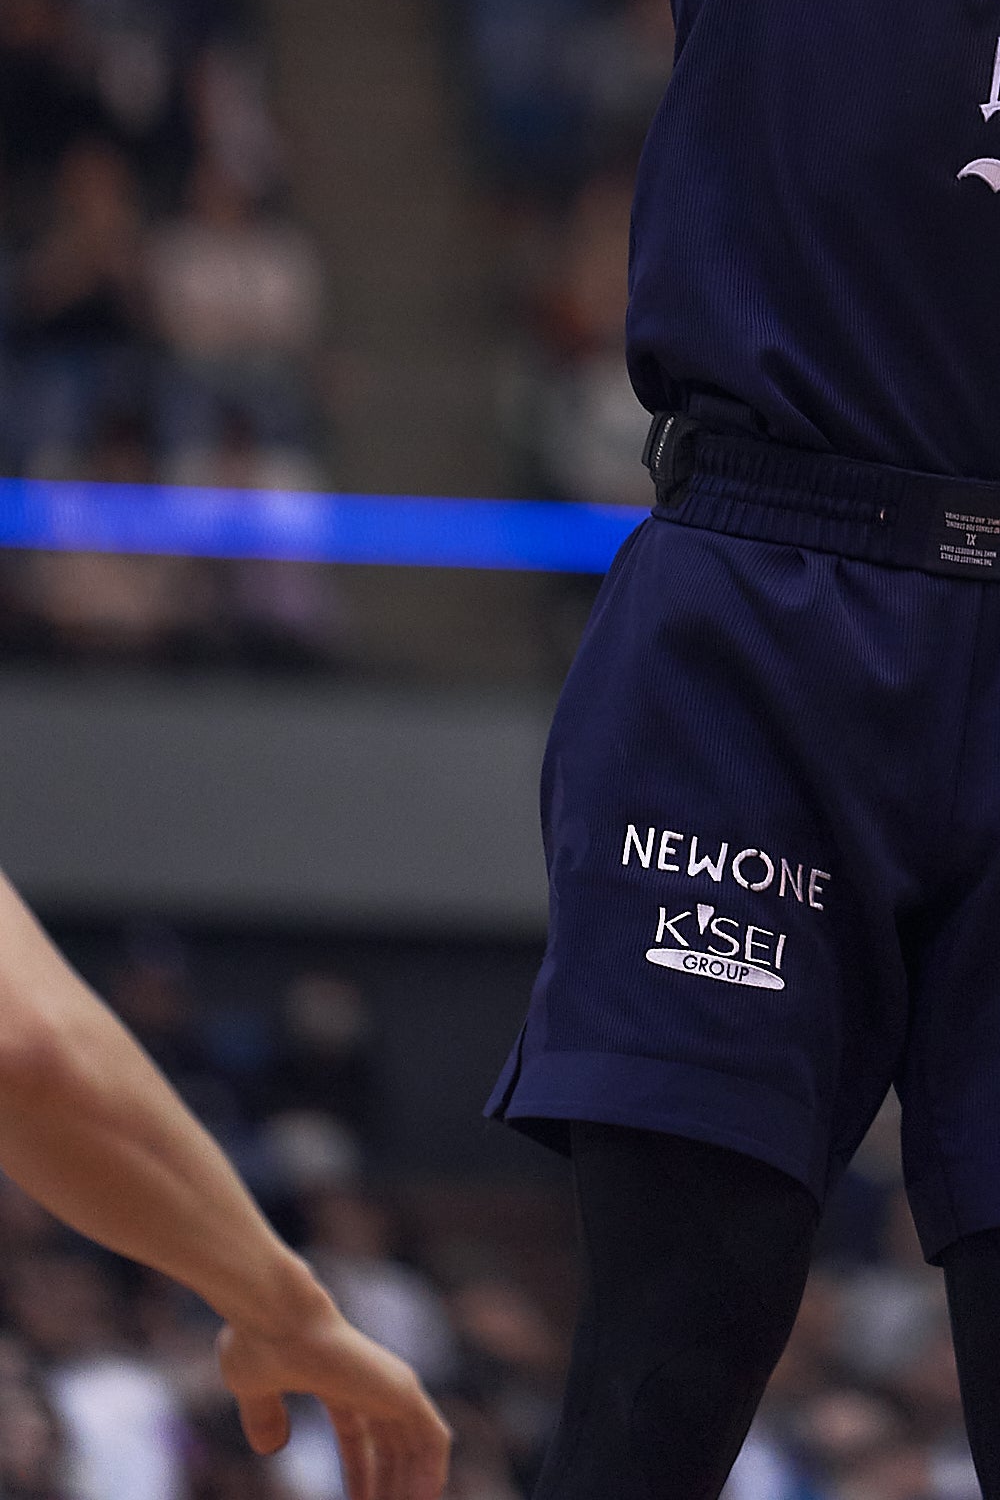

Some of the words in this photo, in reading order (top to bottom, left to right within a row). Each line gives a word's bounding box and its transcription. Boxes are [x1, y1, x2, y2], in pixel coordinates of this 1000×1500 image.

[966, 533, 976, 546] XL
[621, 824, 831, 911] NEWONE
[682, 954, 751, 983] GROUP
